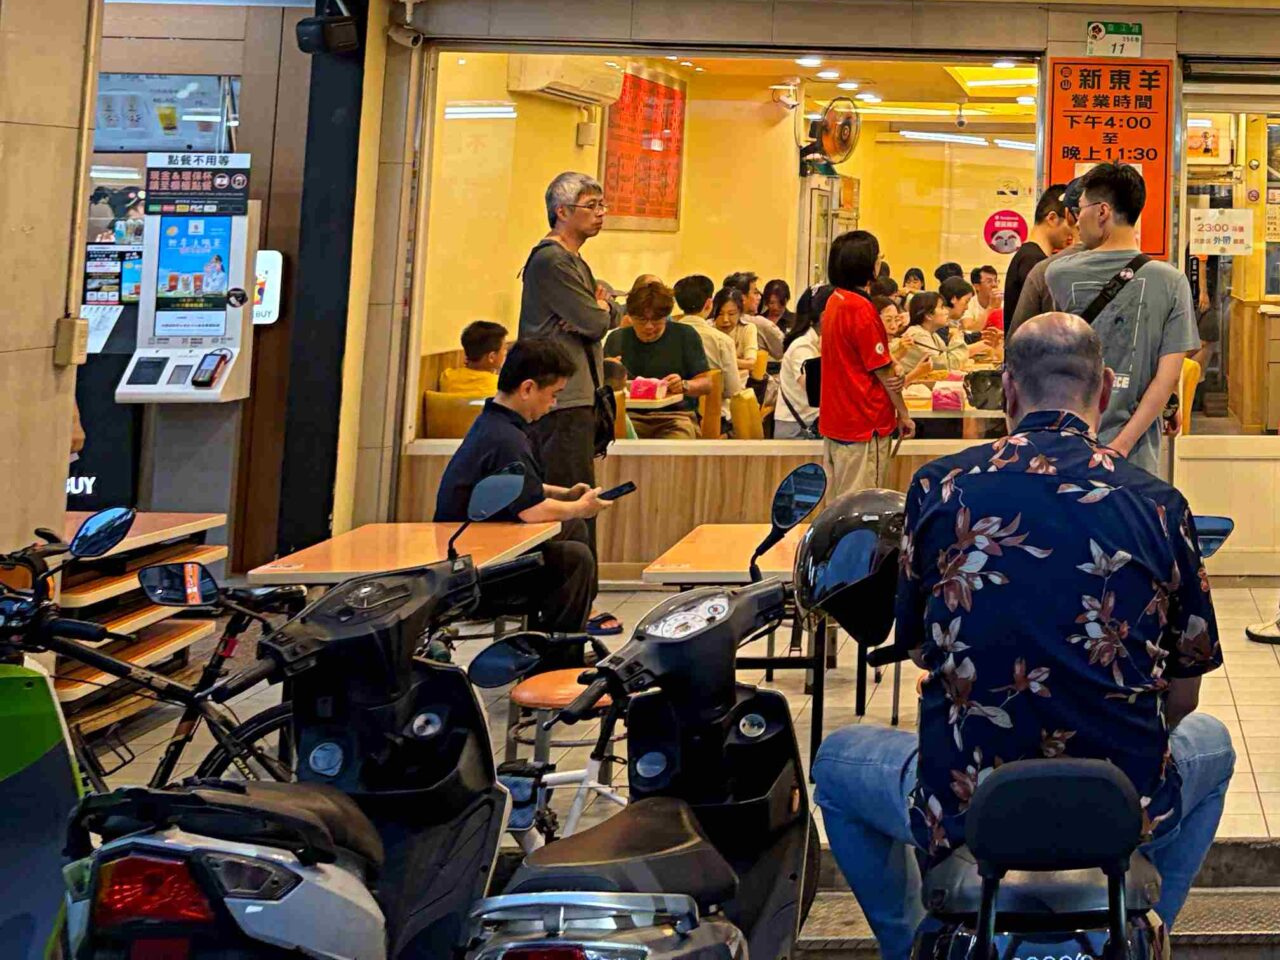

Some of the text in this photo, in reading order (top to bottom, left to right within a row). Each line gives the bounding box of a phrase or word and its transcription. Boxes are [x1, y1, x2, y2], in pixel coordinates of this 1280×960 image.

[1111, 42, 1125, 54] 11
[1079, 68, 1160, 90] 新東羊
[1072, 93, 1152, 109] 營業時間
[1062, 114, 1151, 129] 下午4:00
[1102, 132, 1118, 144] 至
[1062, 145, 1158, 160] 晚上11:30
[1197, 223, 1229, 232] 23:00
